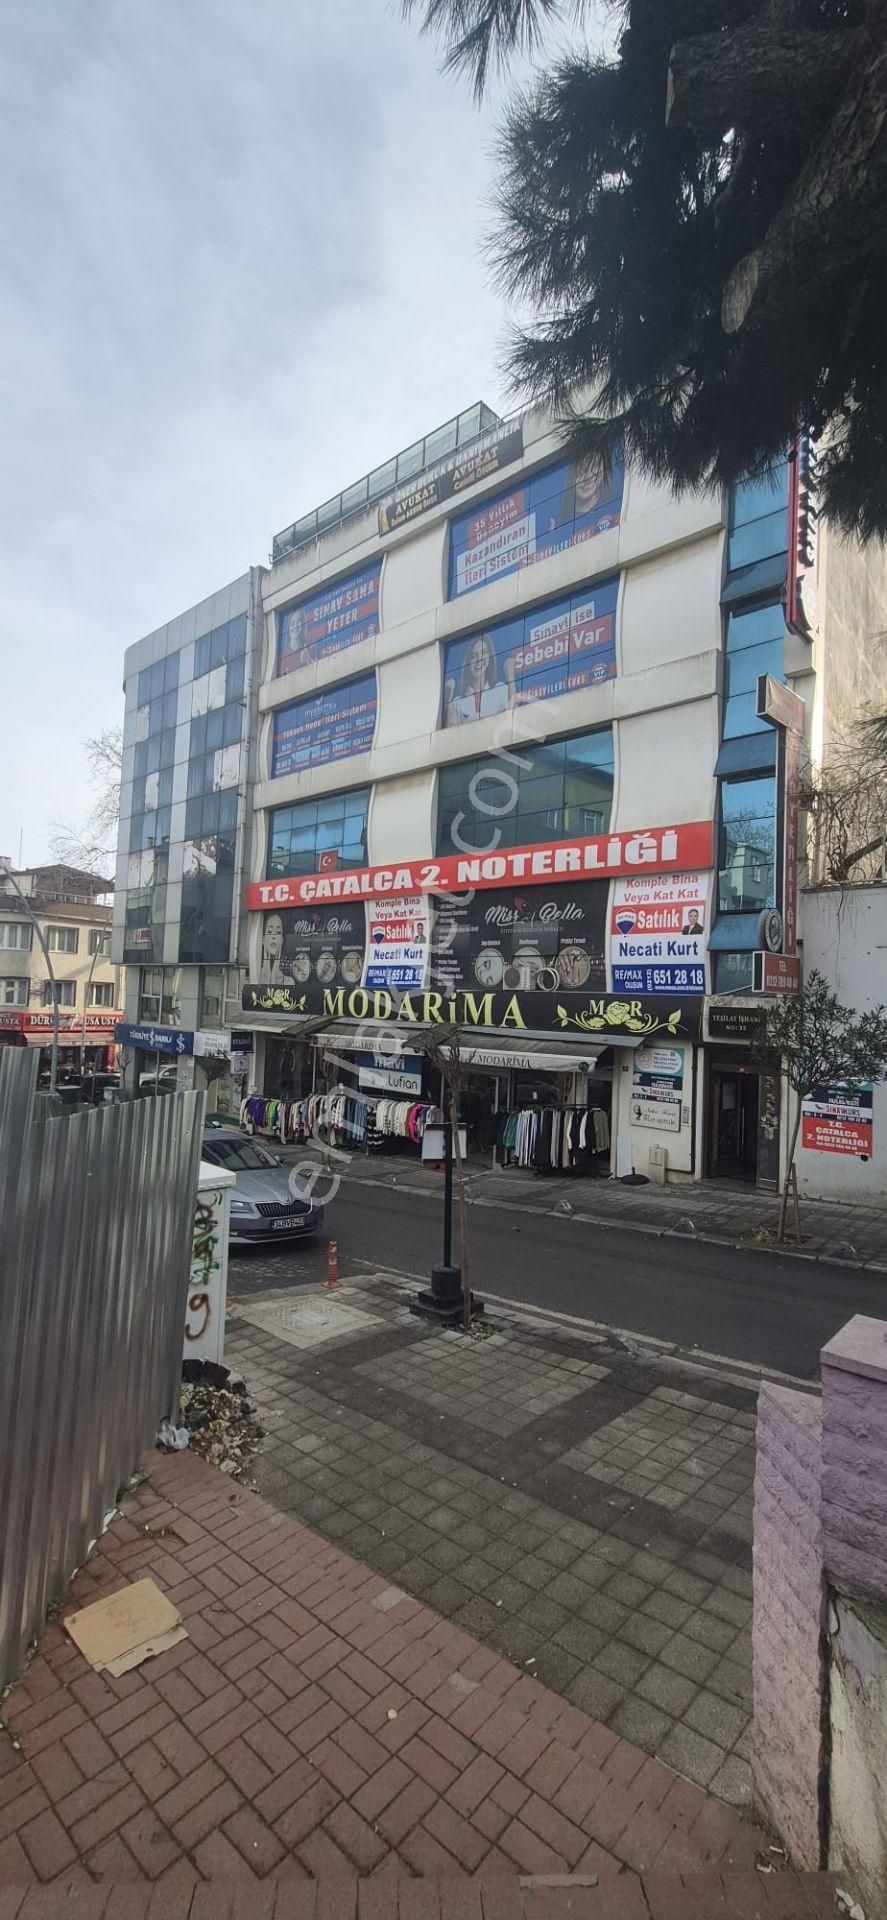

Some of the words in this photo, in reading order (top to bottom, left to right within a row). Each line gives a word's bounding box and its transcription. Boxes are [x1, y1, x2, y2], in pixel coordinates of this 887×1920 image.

[453, 446, 498, 480] AVUKAT
[395, 484, 435, 514] AVUKAT
[465, 526, 525, 566] Kazandıran
[313, 598, 343, 621] SINAV
[515, 635, 569, 669] Sebebi
[572, 627, 605, 650] Var
[260, 885, 295, 904] T.C.
[300, 869, 414, 902] ÇATALCA
[420, 865, 449, 887] 2.
[457, 829, 678, 884] NOTERLİĞİ
[626, 878, 668, 889] Komple
[672, 874, 698, 886] Bina
[375, 899, 401, 909] Komple
[404, 897, 421, 906] Bina
[624, 892, 650, 904] Veya
[654, 890, 674, 901] Kat
[678, 888, 699, 899] Kat
[375, 911, 393, 920] Veya
[394, 909, 407, 917] Kat
[409, 908, 422, 917] Kat
[484, 904, 524, 927] Miss
[539, 902, 586, 924] Bella
[637, 909, 680, 929] Satılık
[294, 919, 320, 937] Miss
[386, 924, 413, 940] Satılık
[374, 949, 401, 960] Necati
[404, 948, 423, 959] Kurt
[620, 942, 662, 957] Necati
[667, 941, 699, 957] Kurt
[392, 969, 404, 981] 651
[405, 969, 414, 981] 28
[614, 969, 643, 980] RE/MAX
[653, 969, 671, 985] 651
[674, 969, 688, 985] 28
[690, 969, 704, 985] 18
[388, 1073, 418, 1090] Lufian
[828, 1121, 846, 1129] T.C.
